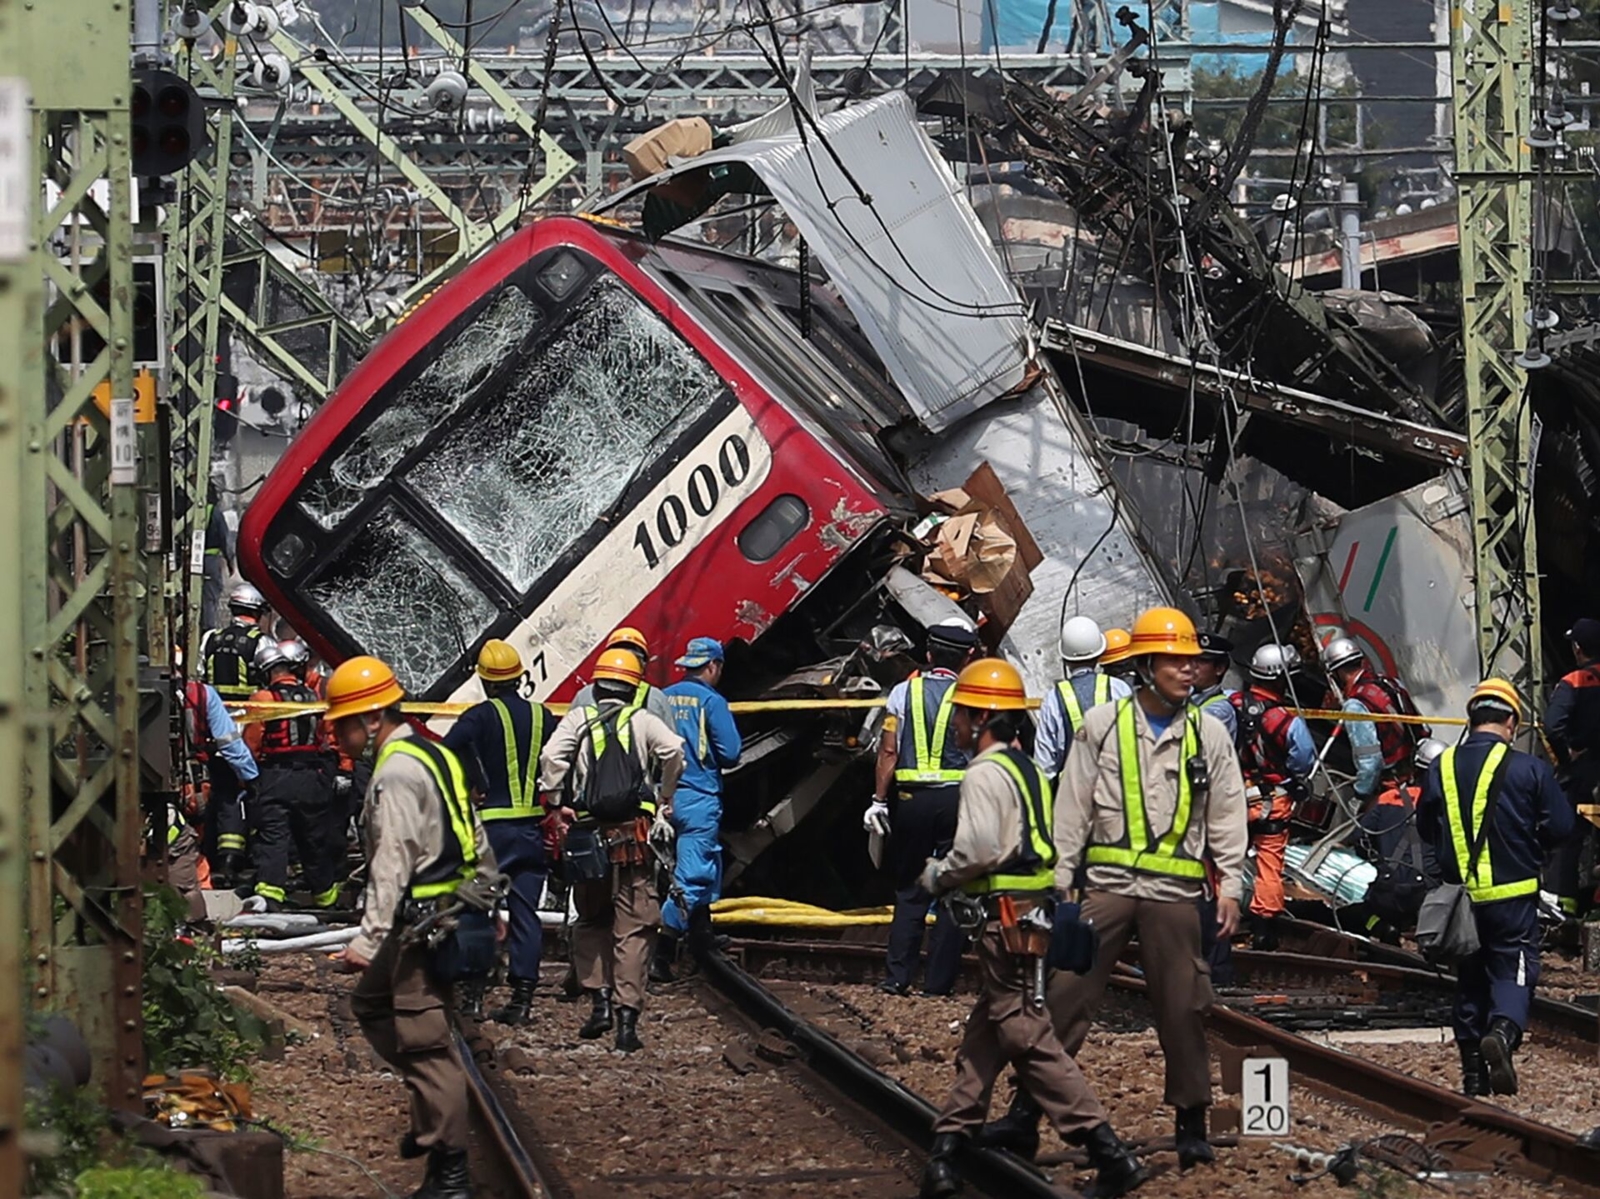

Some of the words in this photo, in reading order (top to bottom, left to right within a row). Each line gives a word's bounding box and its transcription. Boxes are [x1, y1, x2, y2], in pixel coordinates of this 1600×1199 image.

[633, 434, 750, 570] 1000
[1254, 1064, 1271, 1102] 1
[1247, 1105, 1285, 1131] 20
